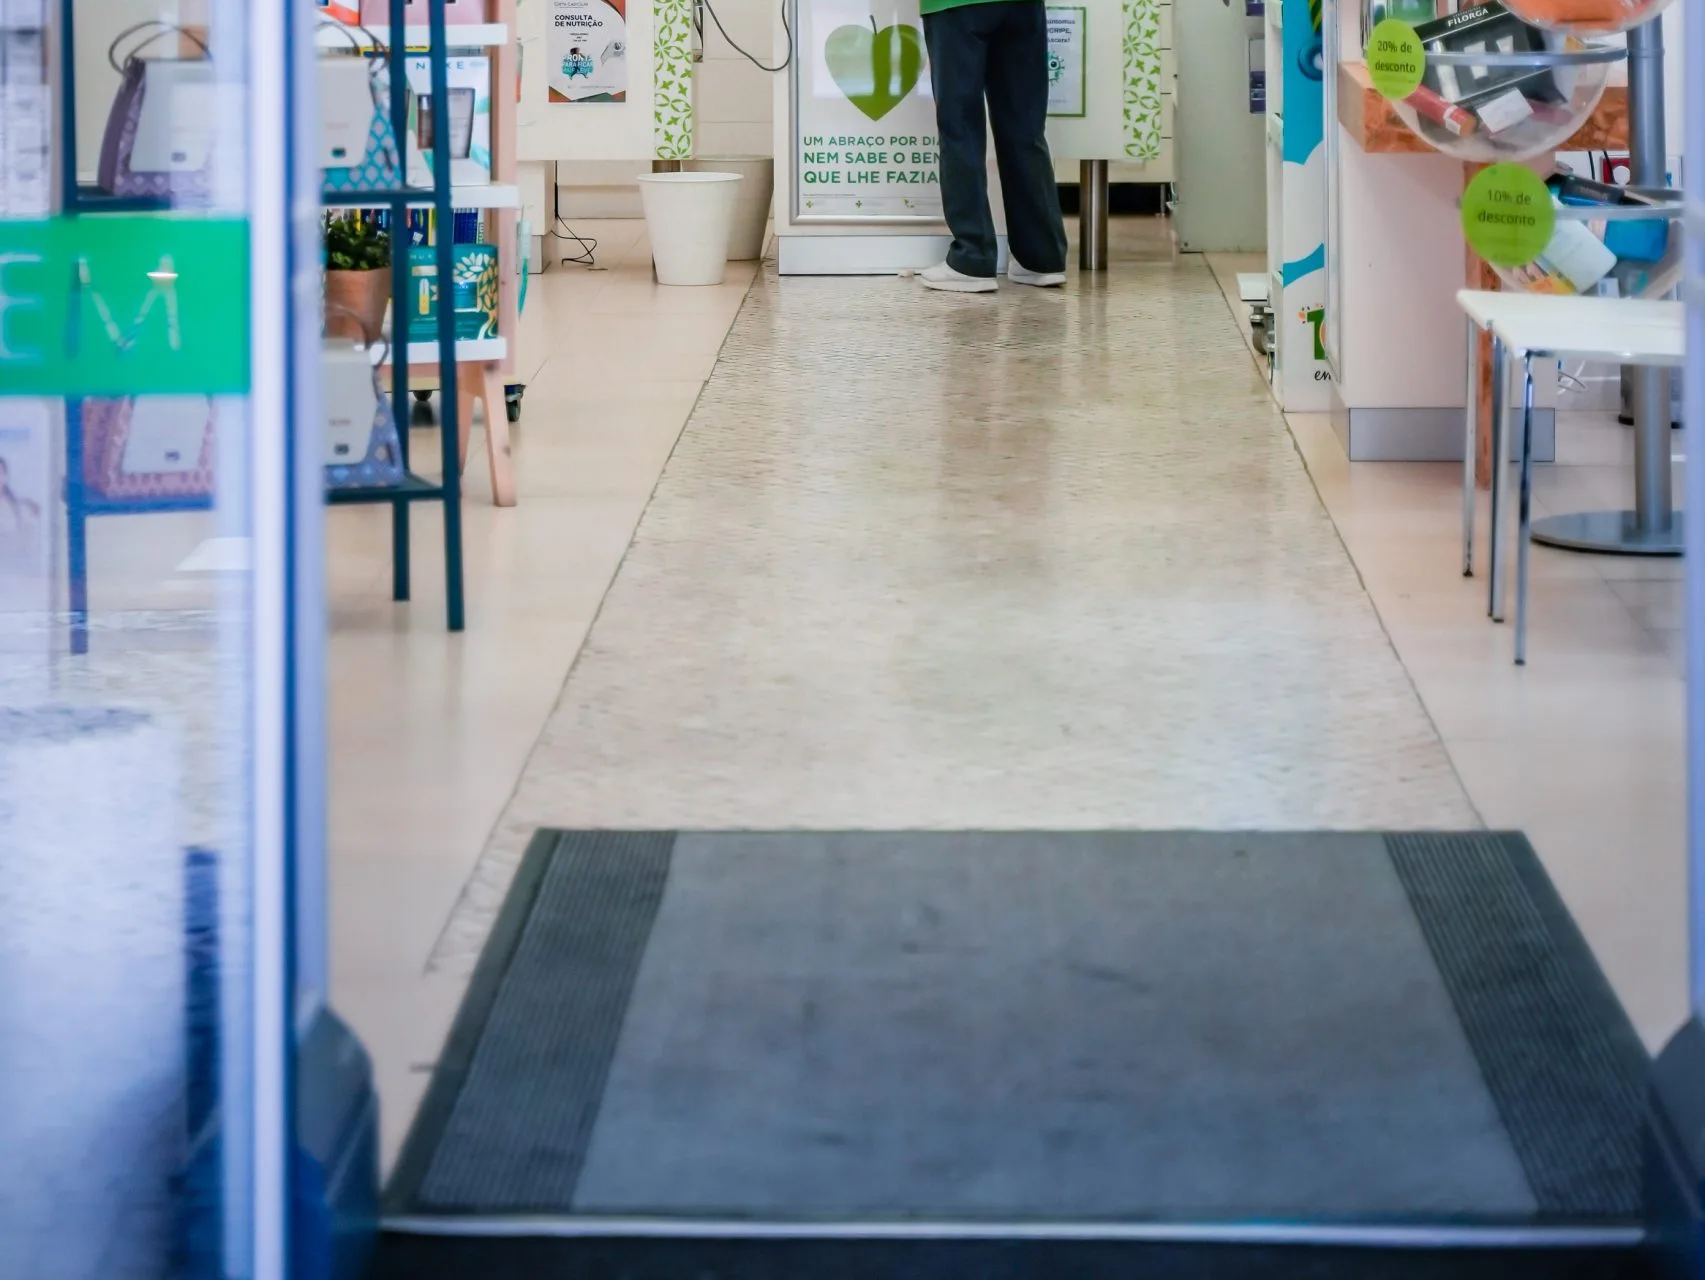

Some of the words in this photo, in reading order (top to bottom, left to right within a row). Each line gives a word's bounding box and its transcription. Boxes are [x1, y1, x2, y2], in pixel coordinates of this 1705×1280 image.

[566, 19, 604, 28] NUTRIÇÃO
[1447, 7, 1489, 28] FILORGA
[1377, 40, 1398, 53] 20%
[1400, 41, 1413, 54] de
[1375, 60, 1417, 74] desconto
[803, 136, 824, 146] UM
[828, 136, 885, 148] ABRAÇO
[890, 136, 918, 146] POR
[804, 152, 839, 164] NEM
[845, 152, 888, 164] SABE
[893, 152, 905, 164] O
[804, 171, 841, 184] QUE
[847, 171, 880, 183] LHE
[886, 171, 939, 183] FAZIA
[1487, 189, 1513, 204] 10%
[1515, 191, 1531, 206] de
[1477, 211, 1536, 227] desconto
